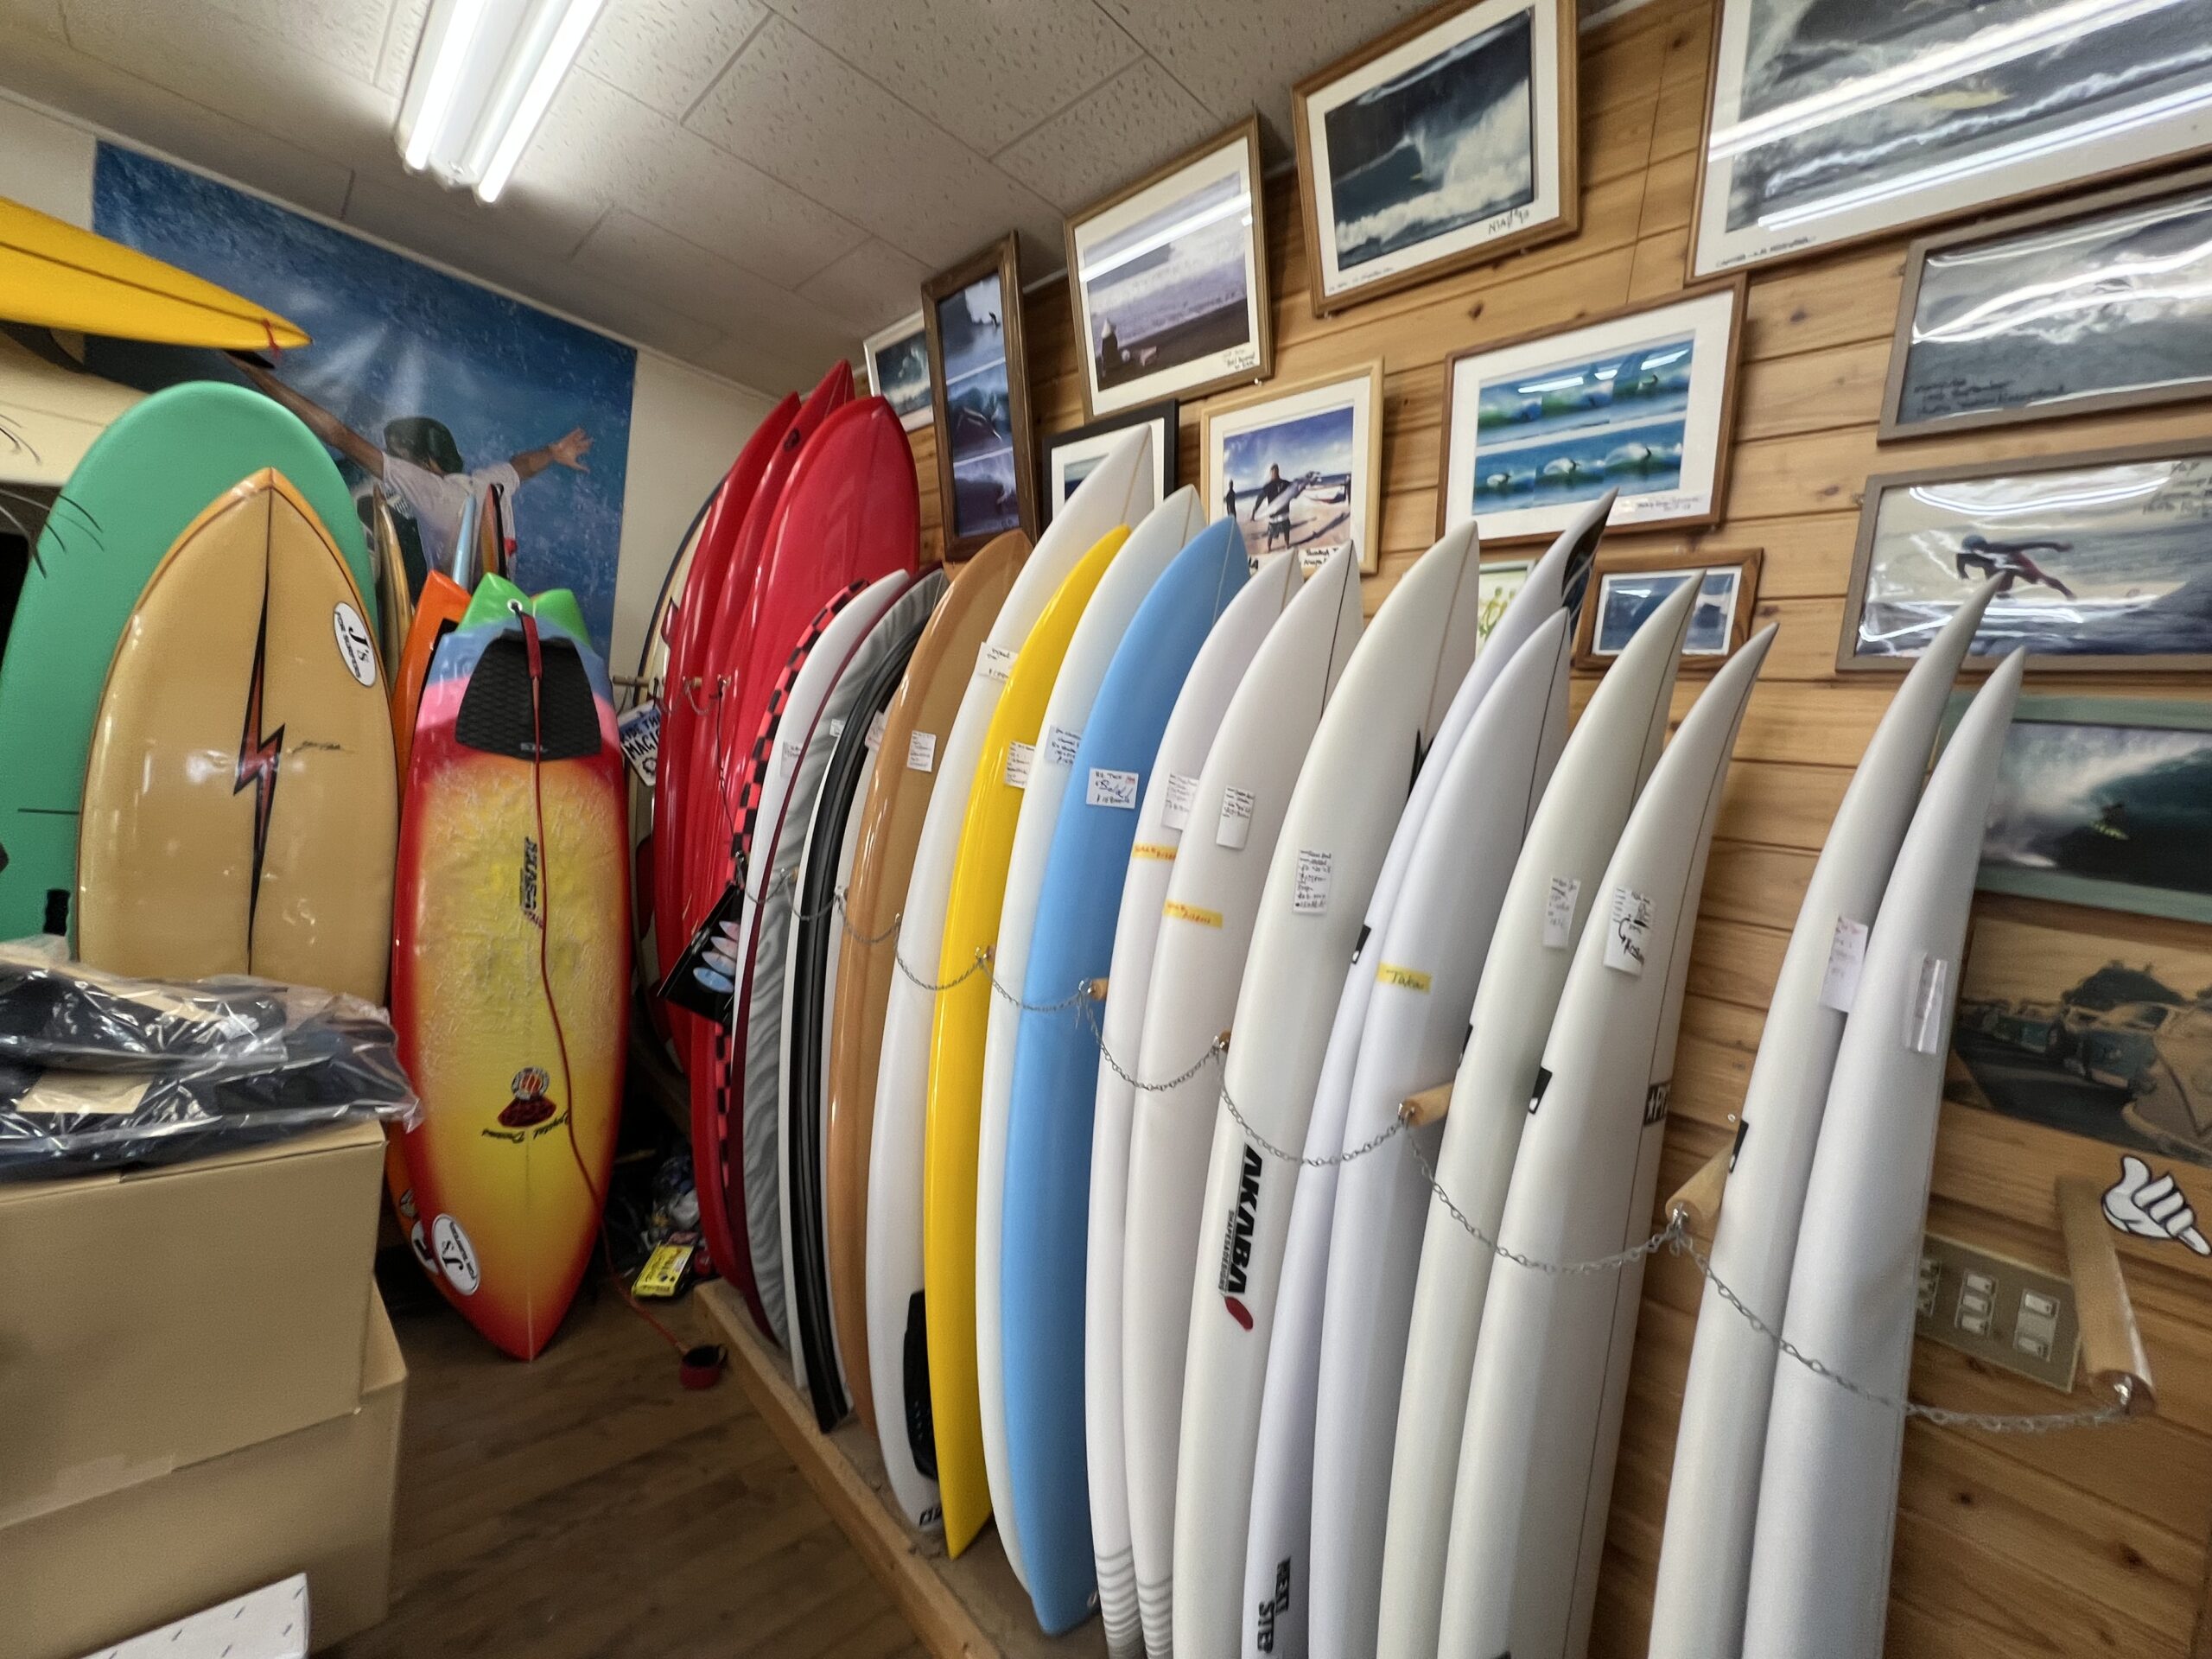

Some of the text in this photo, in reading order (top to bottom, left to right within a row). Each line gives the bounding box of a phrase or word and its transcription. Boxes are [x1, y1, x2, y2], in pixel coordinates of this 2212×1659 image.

[334, 612, 361, 678] FOR SURFERS
[348, 626, 370, 663] J's
[1228, 1142, 1262, 1294] AKABA
[442, 1241, 464, 1270] J's
